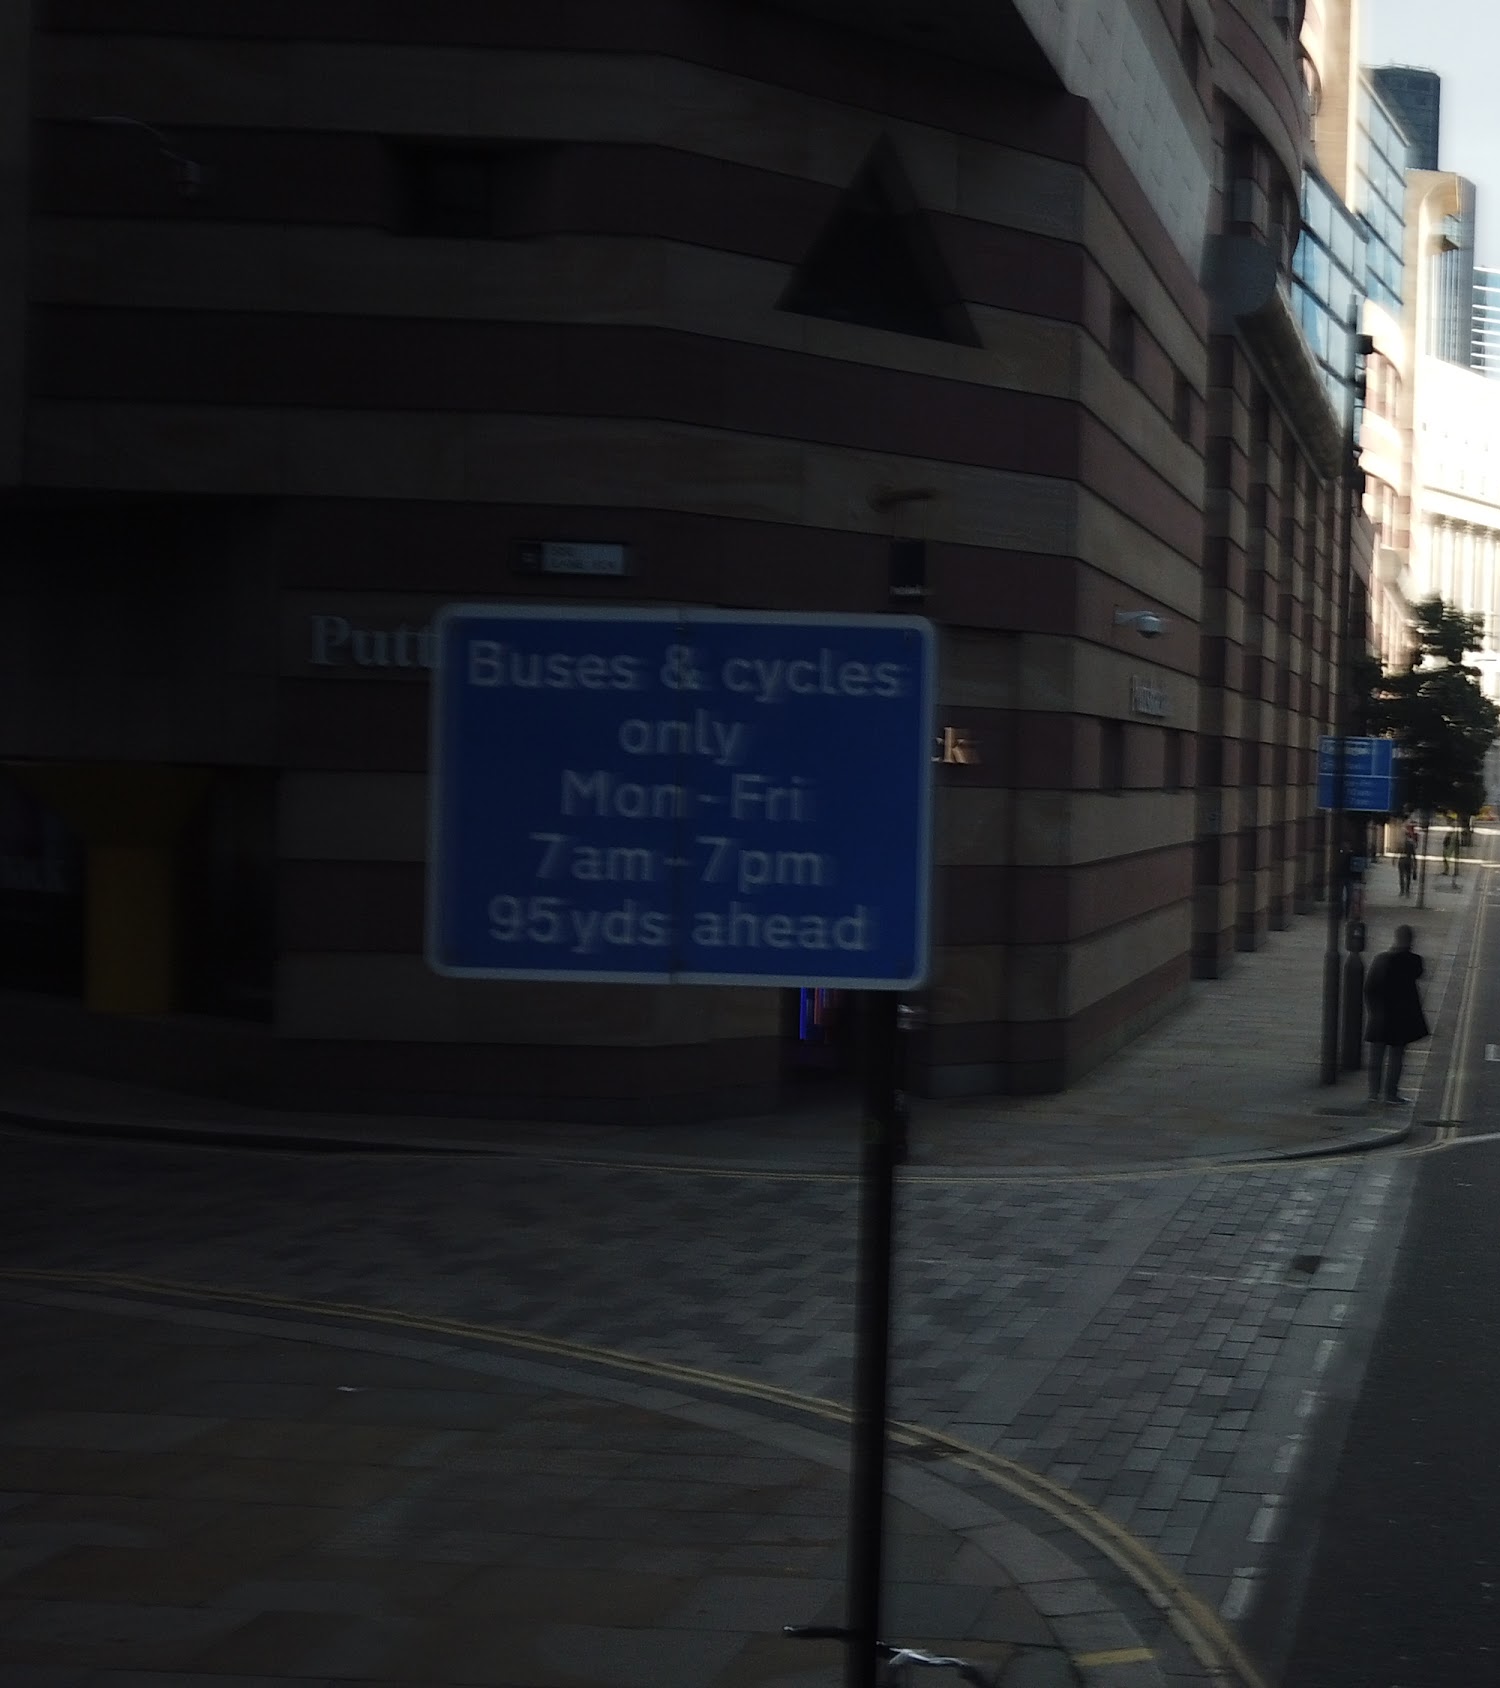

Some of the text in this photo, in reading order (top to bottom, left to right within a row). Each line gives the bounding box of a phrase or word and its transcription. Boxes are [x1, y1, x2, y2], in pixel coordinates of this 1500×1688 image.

[467, 639, 907, 703] Buses & cycles
[618, 708, 747, 765] only
[691, 900, 872, 950] ahead
